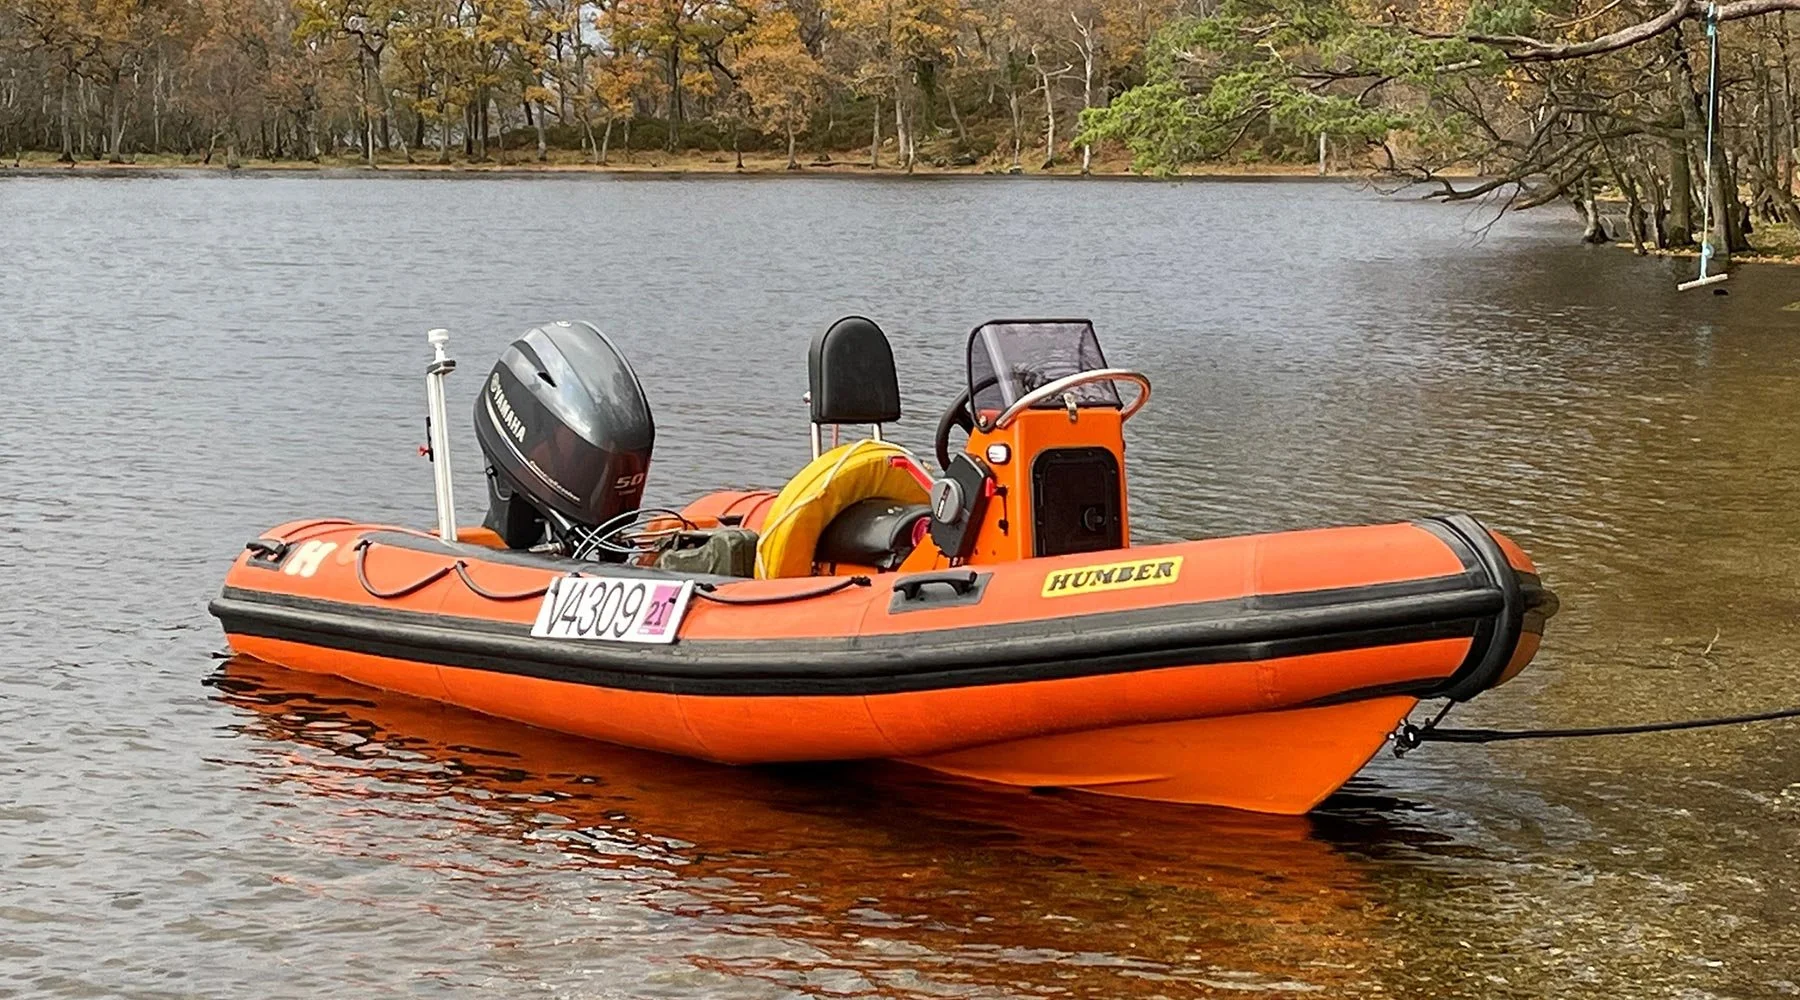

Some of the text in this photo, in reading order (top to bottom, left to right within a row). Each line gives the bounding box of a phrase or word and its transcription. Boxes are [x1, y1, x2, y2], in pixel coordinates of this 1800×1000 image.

[492, 384, 527, 443] YAMAHA
[613, 472, 645, 489] 50
[1047, 561, 1175, 592] HUMBER
[546, 580, 646, 638] V4309
[642, 601, 667, 626] 21
